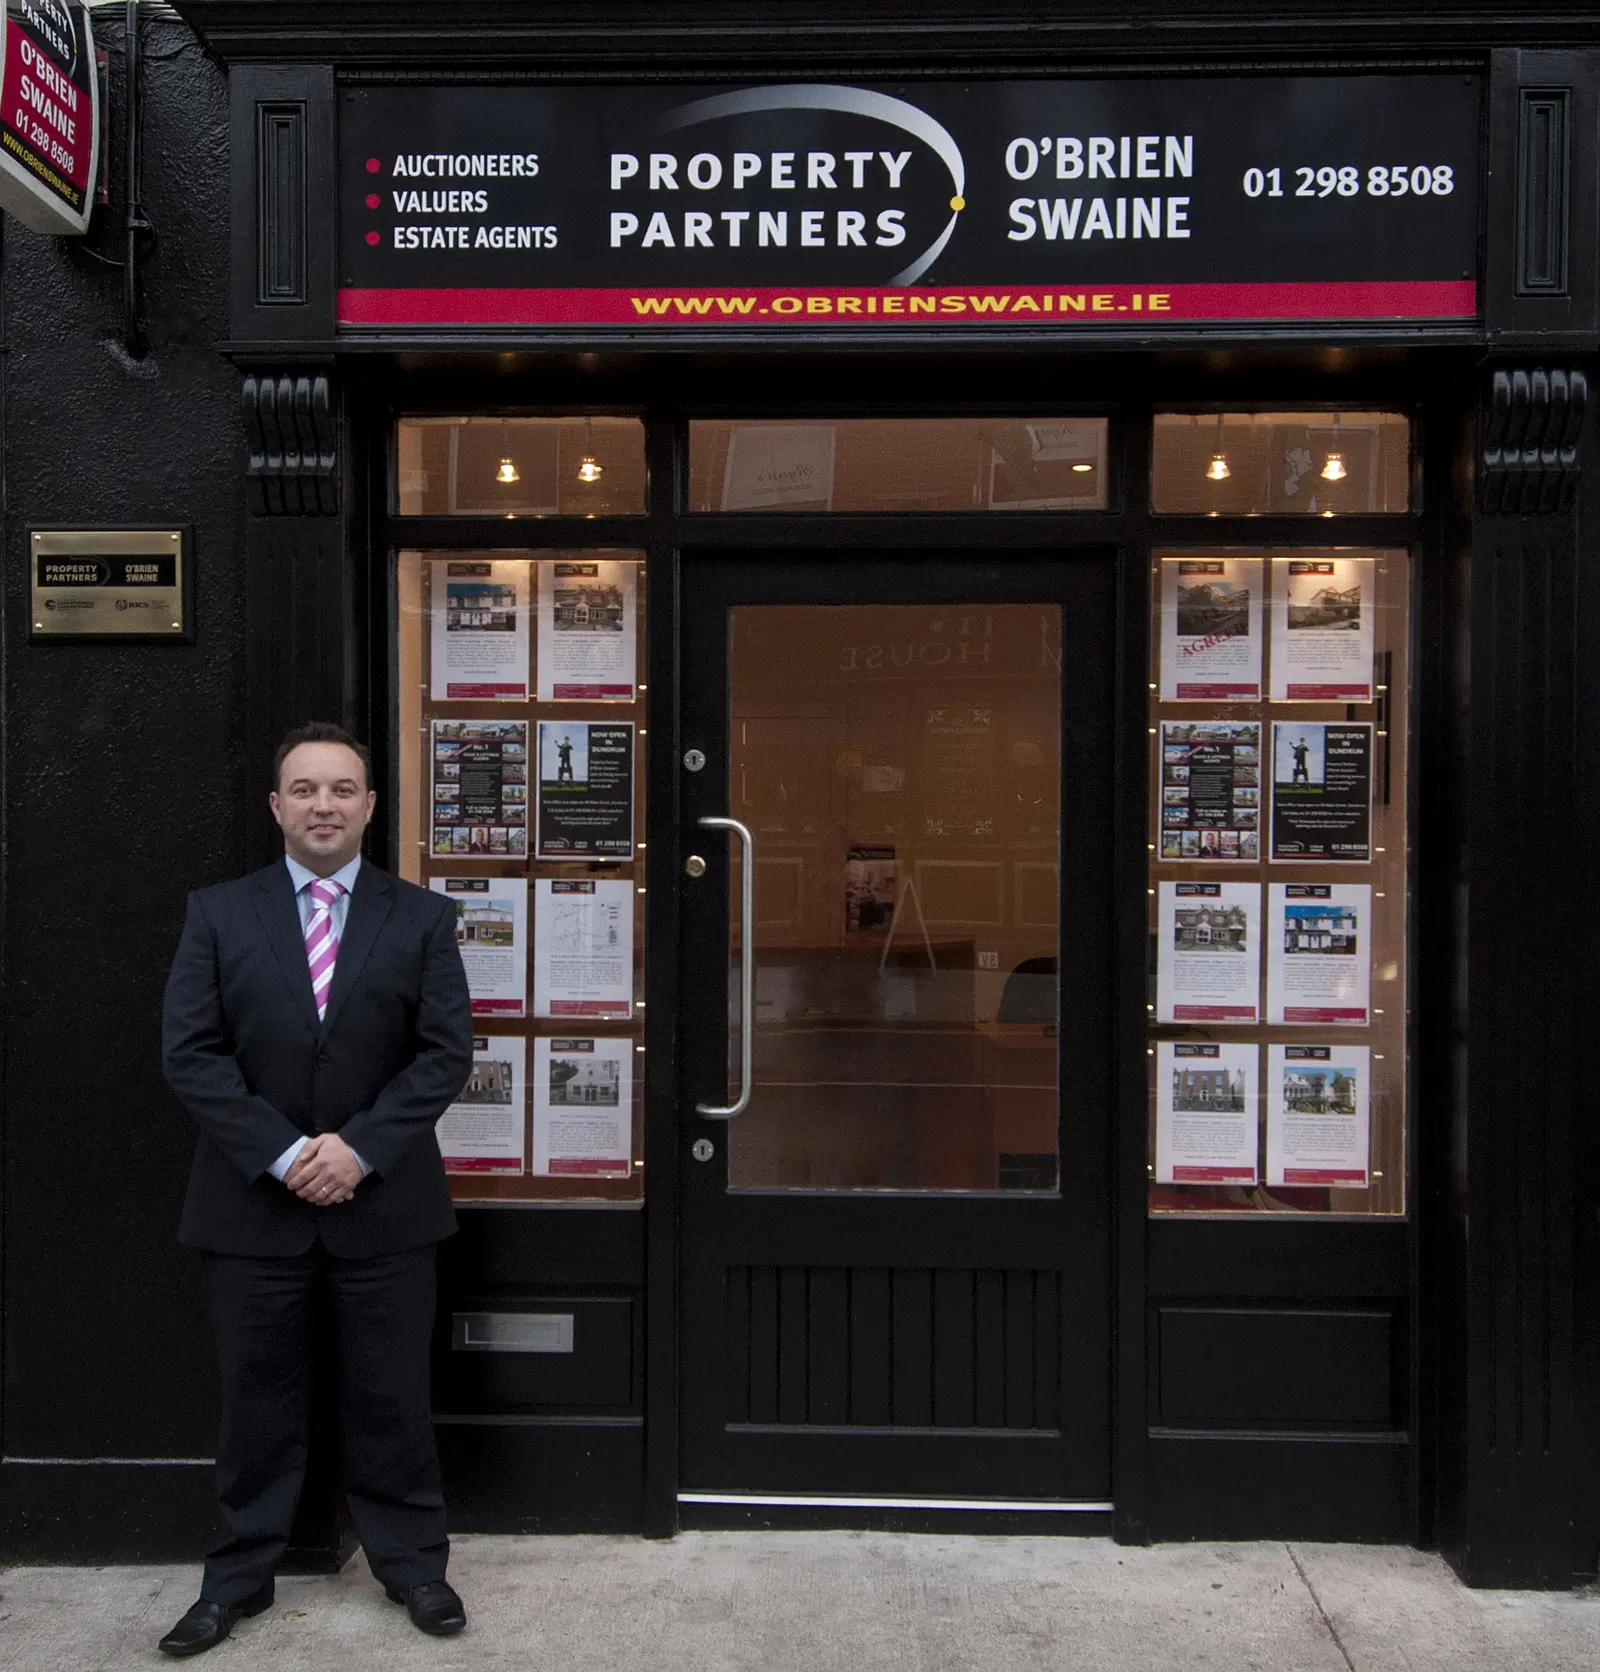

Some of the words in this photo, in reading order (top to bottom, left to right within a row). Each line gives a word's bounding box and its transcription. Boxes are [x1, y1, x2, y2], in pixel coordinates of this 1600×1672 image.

[21, 0, 70, 60] PARTNERS
[20, 39, 78, 113] O'BRIEN
[20, 75, 76, 145] SWAINE
[16, 109, 29, 134] 01
[30, 122, 49, 152] 298
[51, 140, 74, 174] 8508
[1005, 135, 1193, 181] O'BRIEN
[392, 153, 539, 177] AUCTIONEERS
[610, 151, 912, 190] PROPERTY
[1243, 167, 1284, 198] 01
[1295, 166, 1360, 198] 298
[1366, 165, 1455, 197] 8508
[392, 189, 488, 213] VALUERS
[610, 209, 907, 248] PARTNERS
[1007, 196, 1191, 242] SWAINE
[394, 226, 470, 249] ESTATE
[474, 225, 558, 249] AGENTS
[631, 293, 1172, 314] WWW.OBRIENSWAINE.IE
[46, 564, 97, 573] PROPERTY
[46, 573, 97, 582] PARTNERS
[125, 564, 159, 573] O'BRIEN
[126, 573, 158, 582] SWAINE
